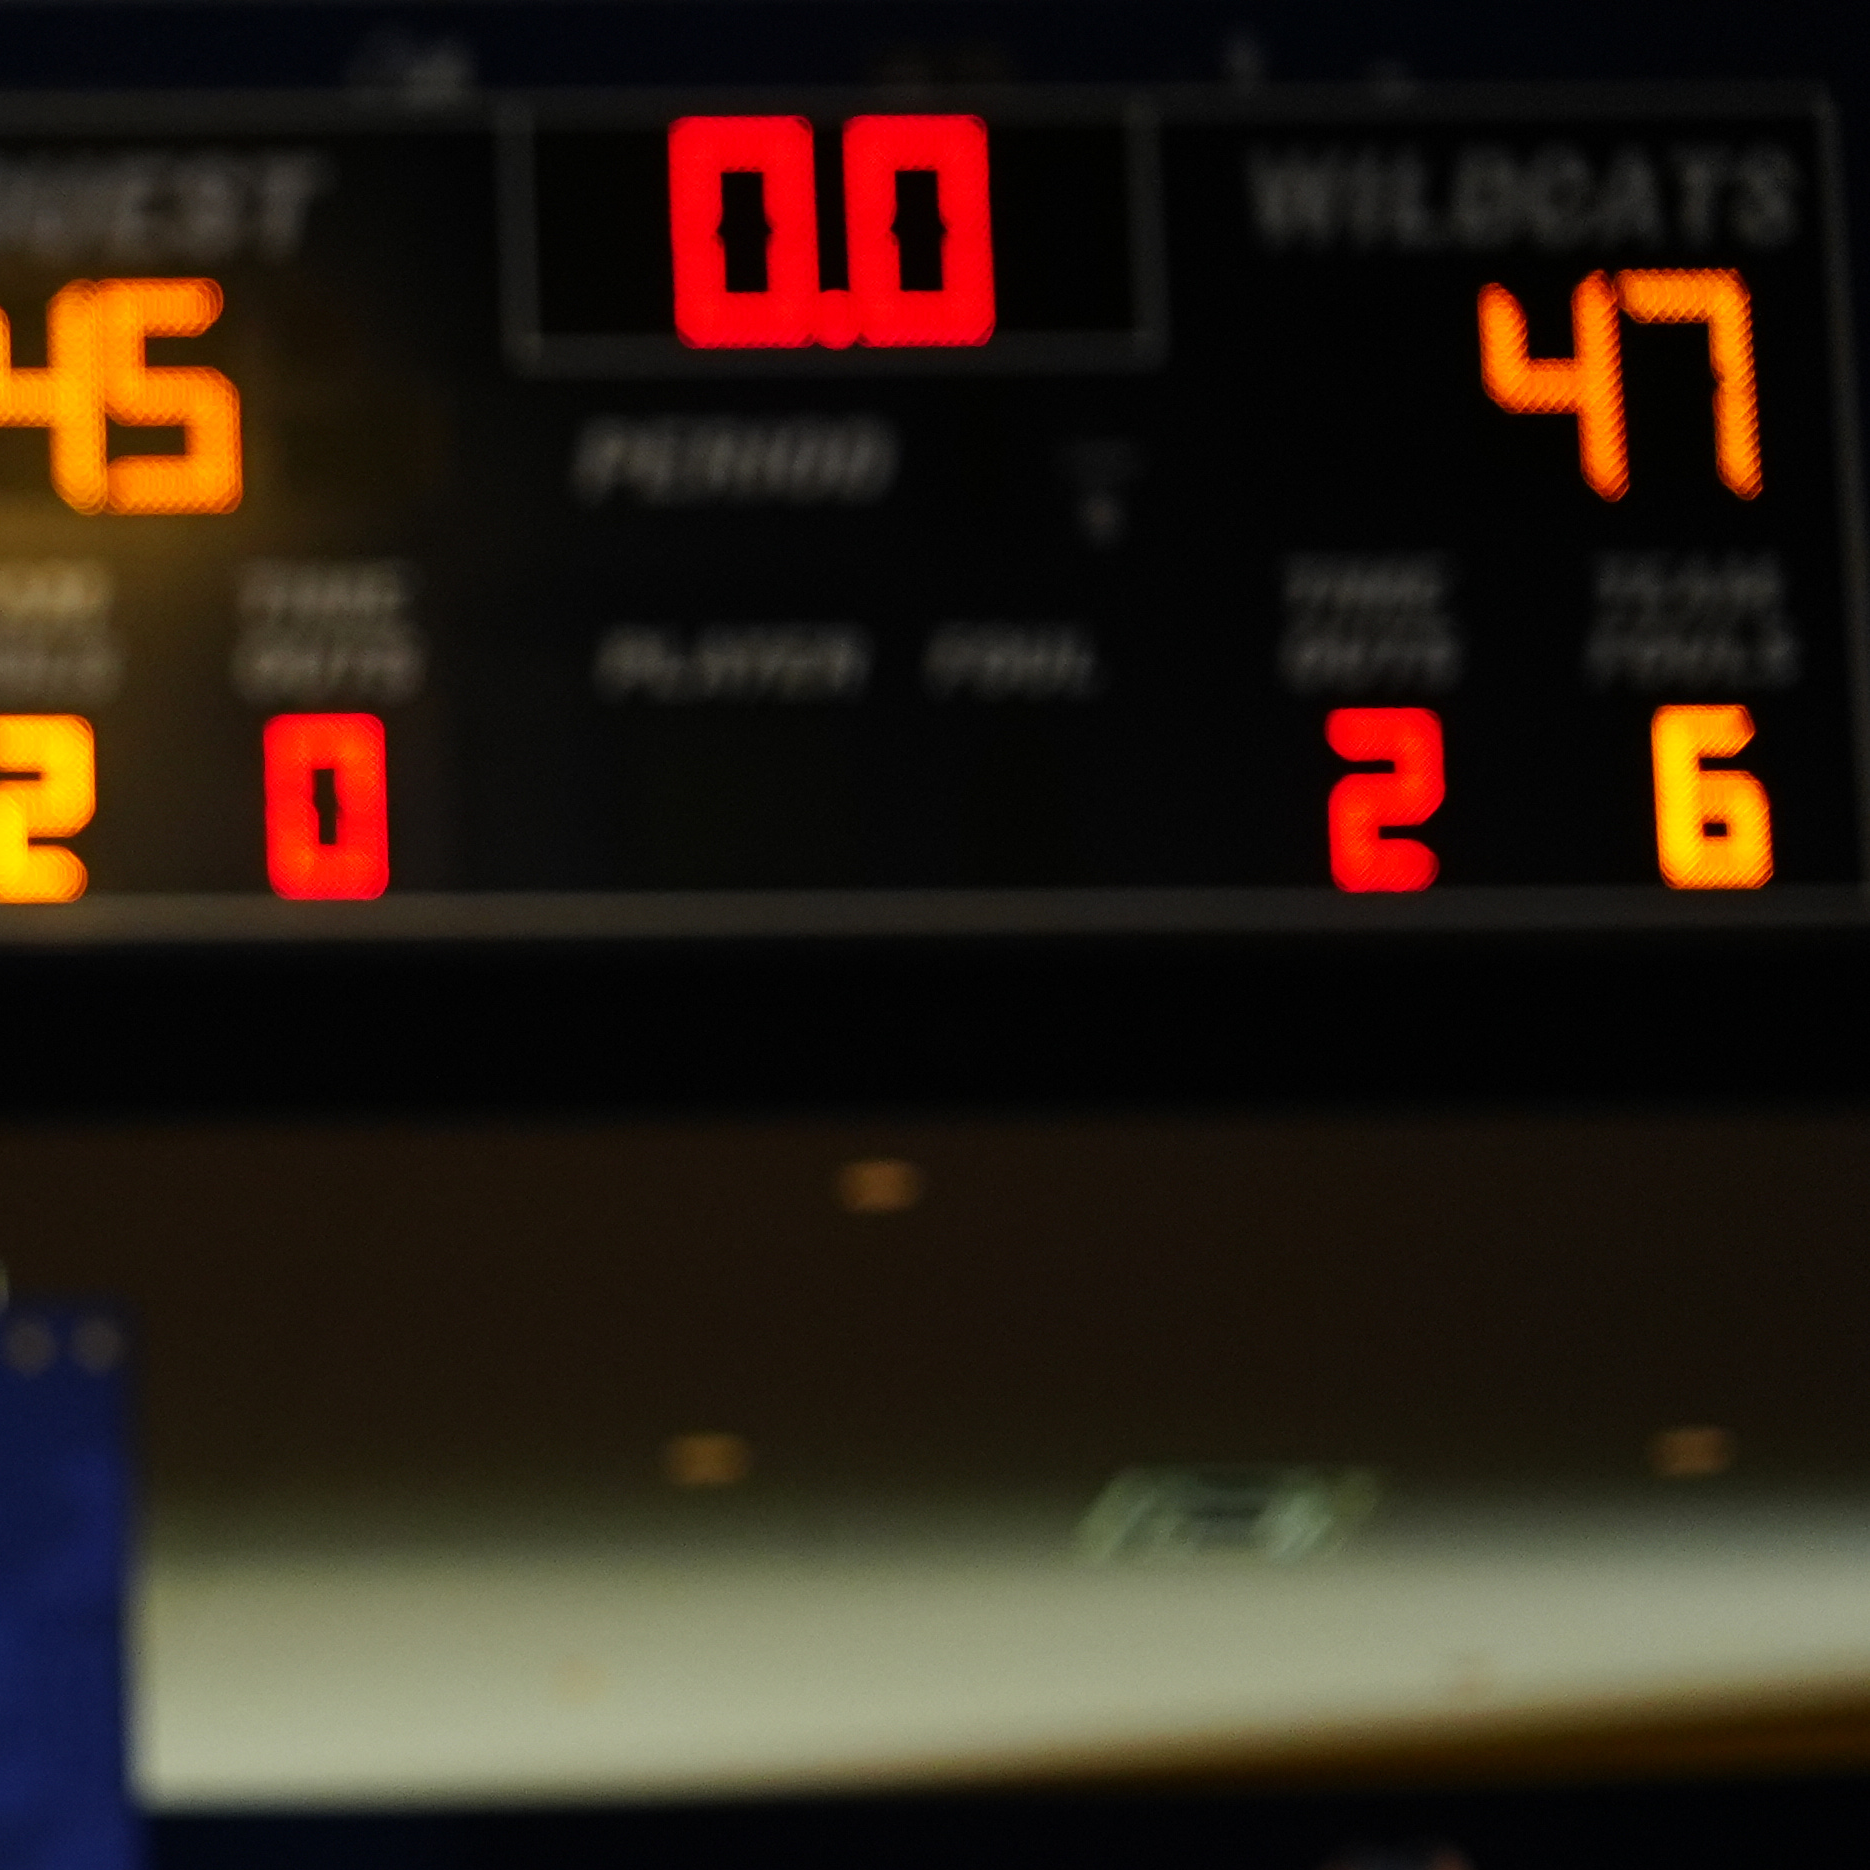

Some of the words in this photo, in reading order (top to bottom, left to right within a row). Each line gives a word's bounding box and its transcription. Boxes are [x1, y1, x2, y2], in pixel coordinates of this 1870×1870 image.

[667, 113, 997, 351] 0.0
[1245, 143, 1805, 255] WILDCATS
[572, 412, 902, 502] PERIOD
[1477, 268, 1763, 502] 47
[262, 711, 391, 900] 0
[1323, 706, 1447, 893] 2
[1650, 703, 1775, 891] 6
